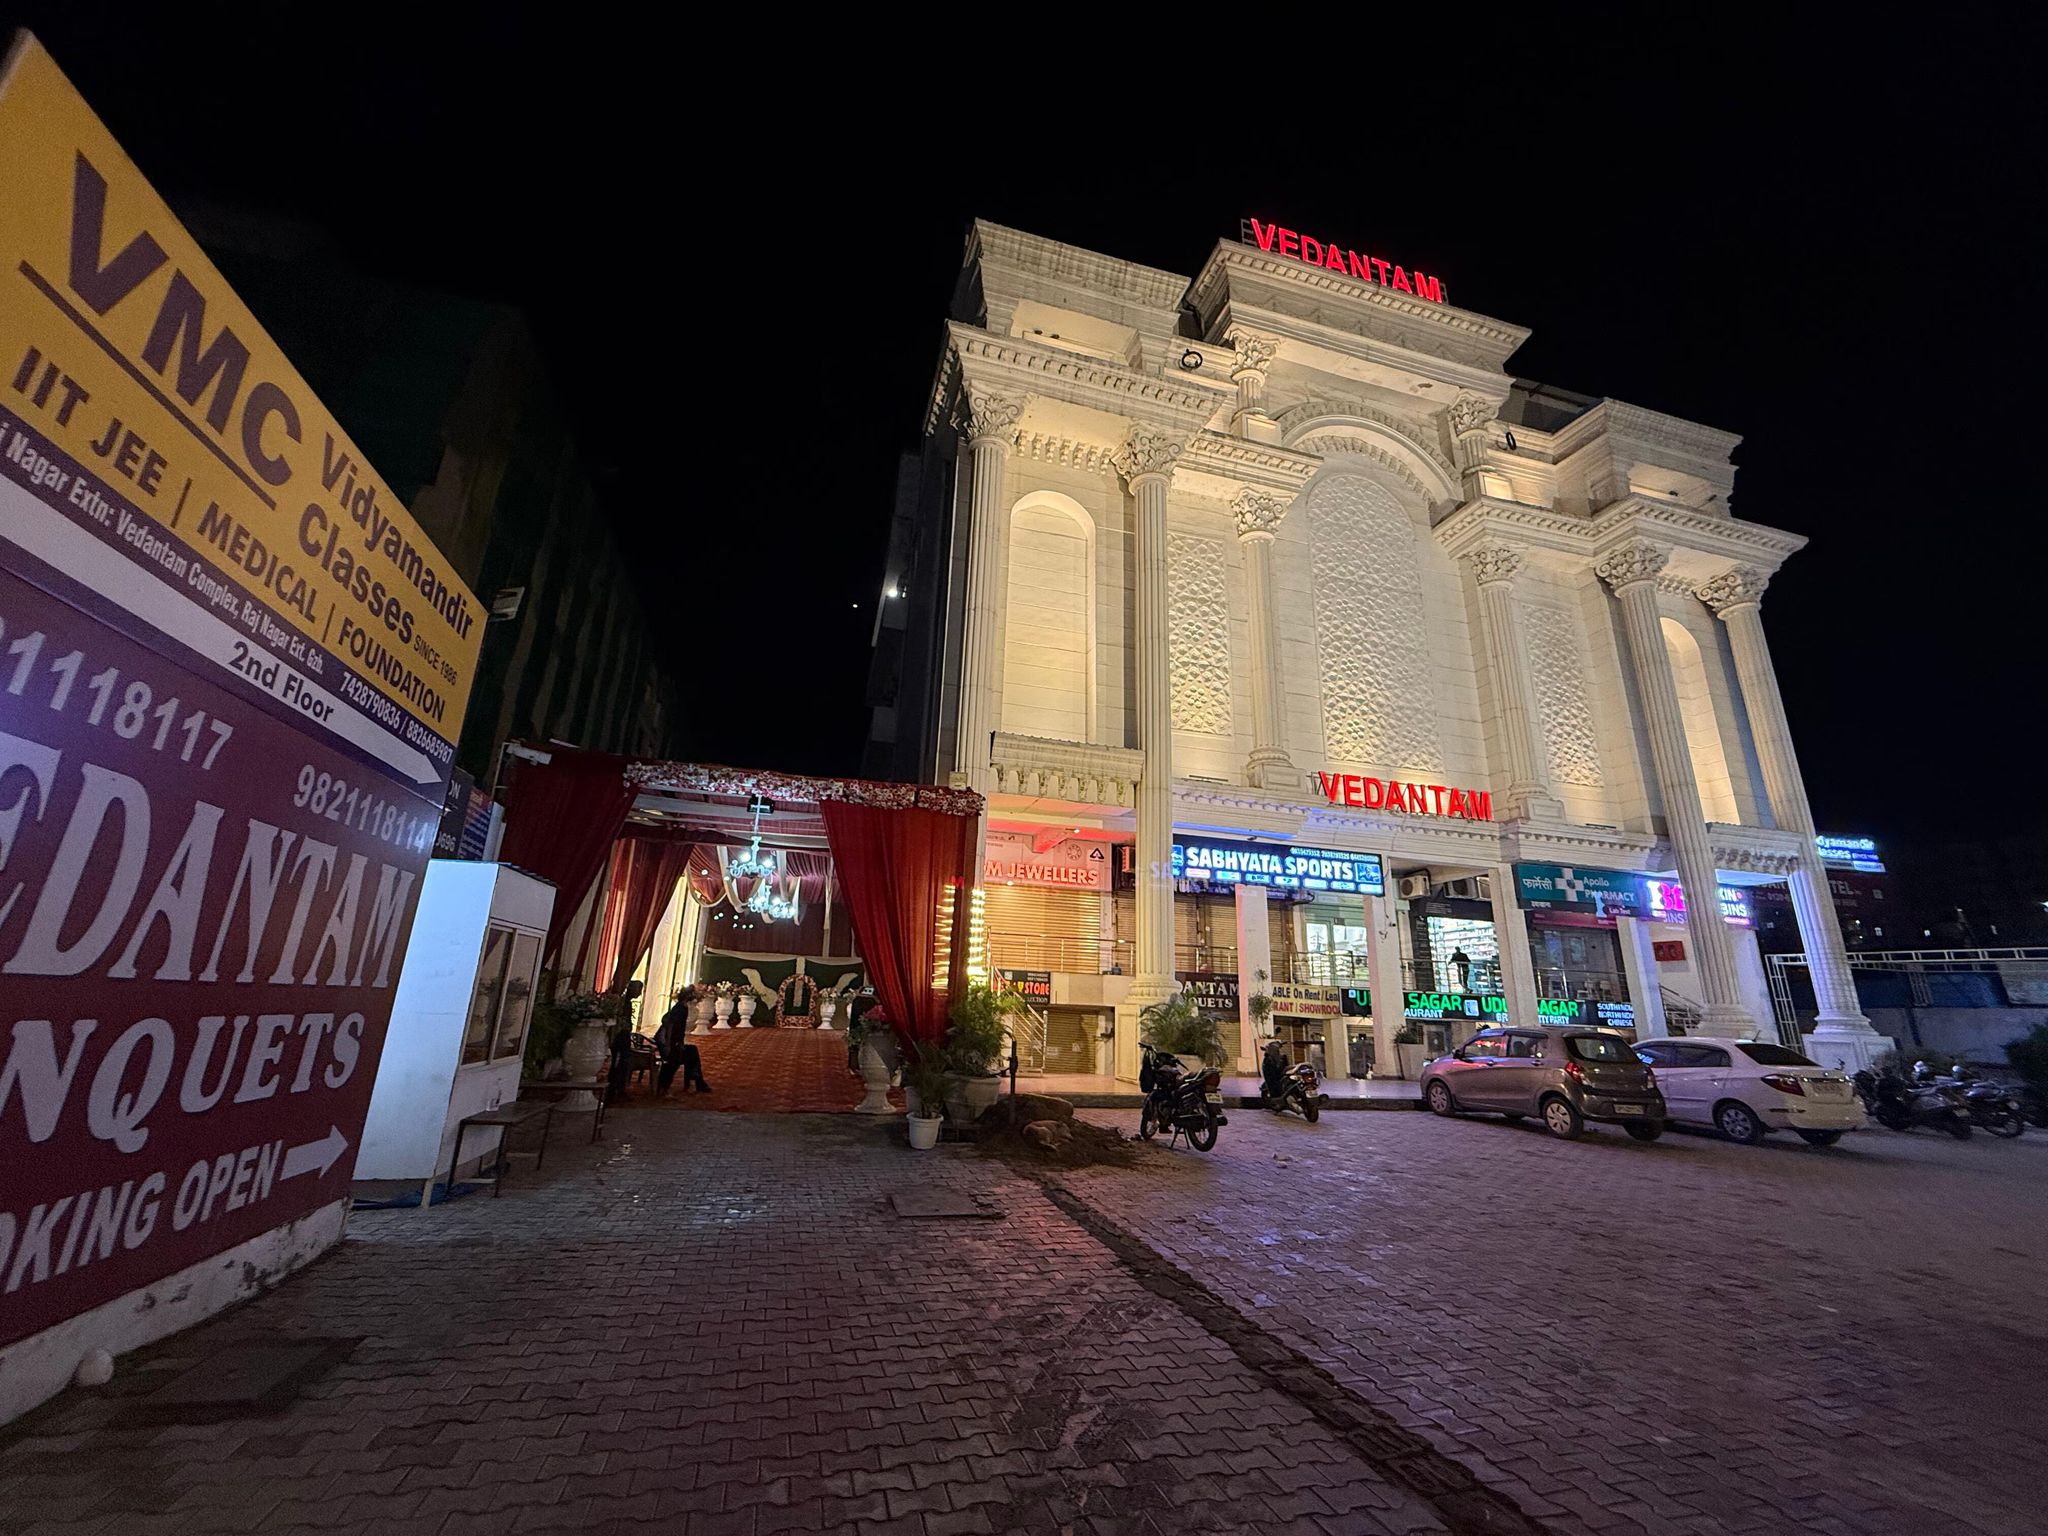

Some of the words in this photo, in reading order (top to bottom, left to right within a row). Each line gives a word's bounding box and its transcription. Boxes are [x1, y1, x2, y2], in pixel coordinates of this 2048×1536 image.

[1250, 218, 1443, 303] VEDANTAM
[68, 148, 302, 487] VMC
[11, 344, 89, 428] IIT
[90, 417, 168, 497] JEE
[197, 501, 317, 623] MEDICAL
[338, 616, 446, 722] FOUNDATION
[298, 502, 415, 644] Classes
[322, 431, 473, 640] Vidyamandir
[6, 432, 70, 494] Nagar
[116, 508, 188, 578] Vedantam
[187, 562, 239, 619] Complex,
[241, 599, 262, 634] Raj
[260, 613, 290, 650] Nagar
[340, 670, 401, 729] 7428790836
[0, 616, 234, 770] 1118117
[228, 640, 280, 690] 2nd
[282, 672, 335, 722] Floor
[413, 634, 440, 671] SINCE
[293, 764, 428, 854] 9821118114
[1318, 770, 1493, 822] VEDANTAM
[1006, 862, 1100, 886] JEWELLERS
[1185, 846, 1283, 875] SABHYATA
[1284, 855, 1354, 881] SPORTS
[1583, 876, 1610, 887] Apollo
[1584, 888, 1635, 902] PHARMACY
[1304, 988, 1321, 1001] Rent
[1407, 992, 1463, 1011] SAGAR
[1537, 999, 1580, 1017] AGAR
[172, 1139, 283, 1232] OPEN
